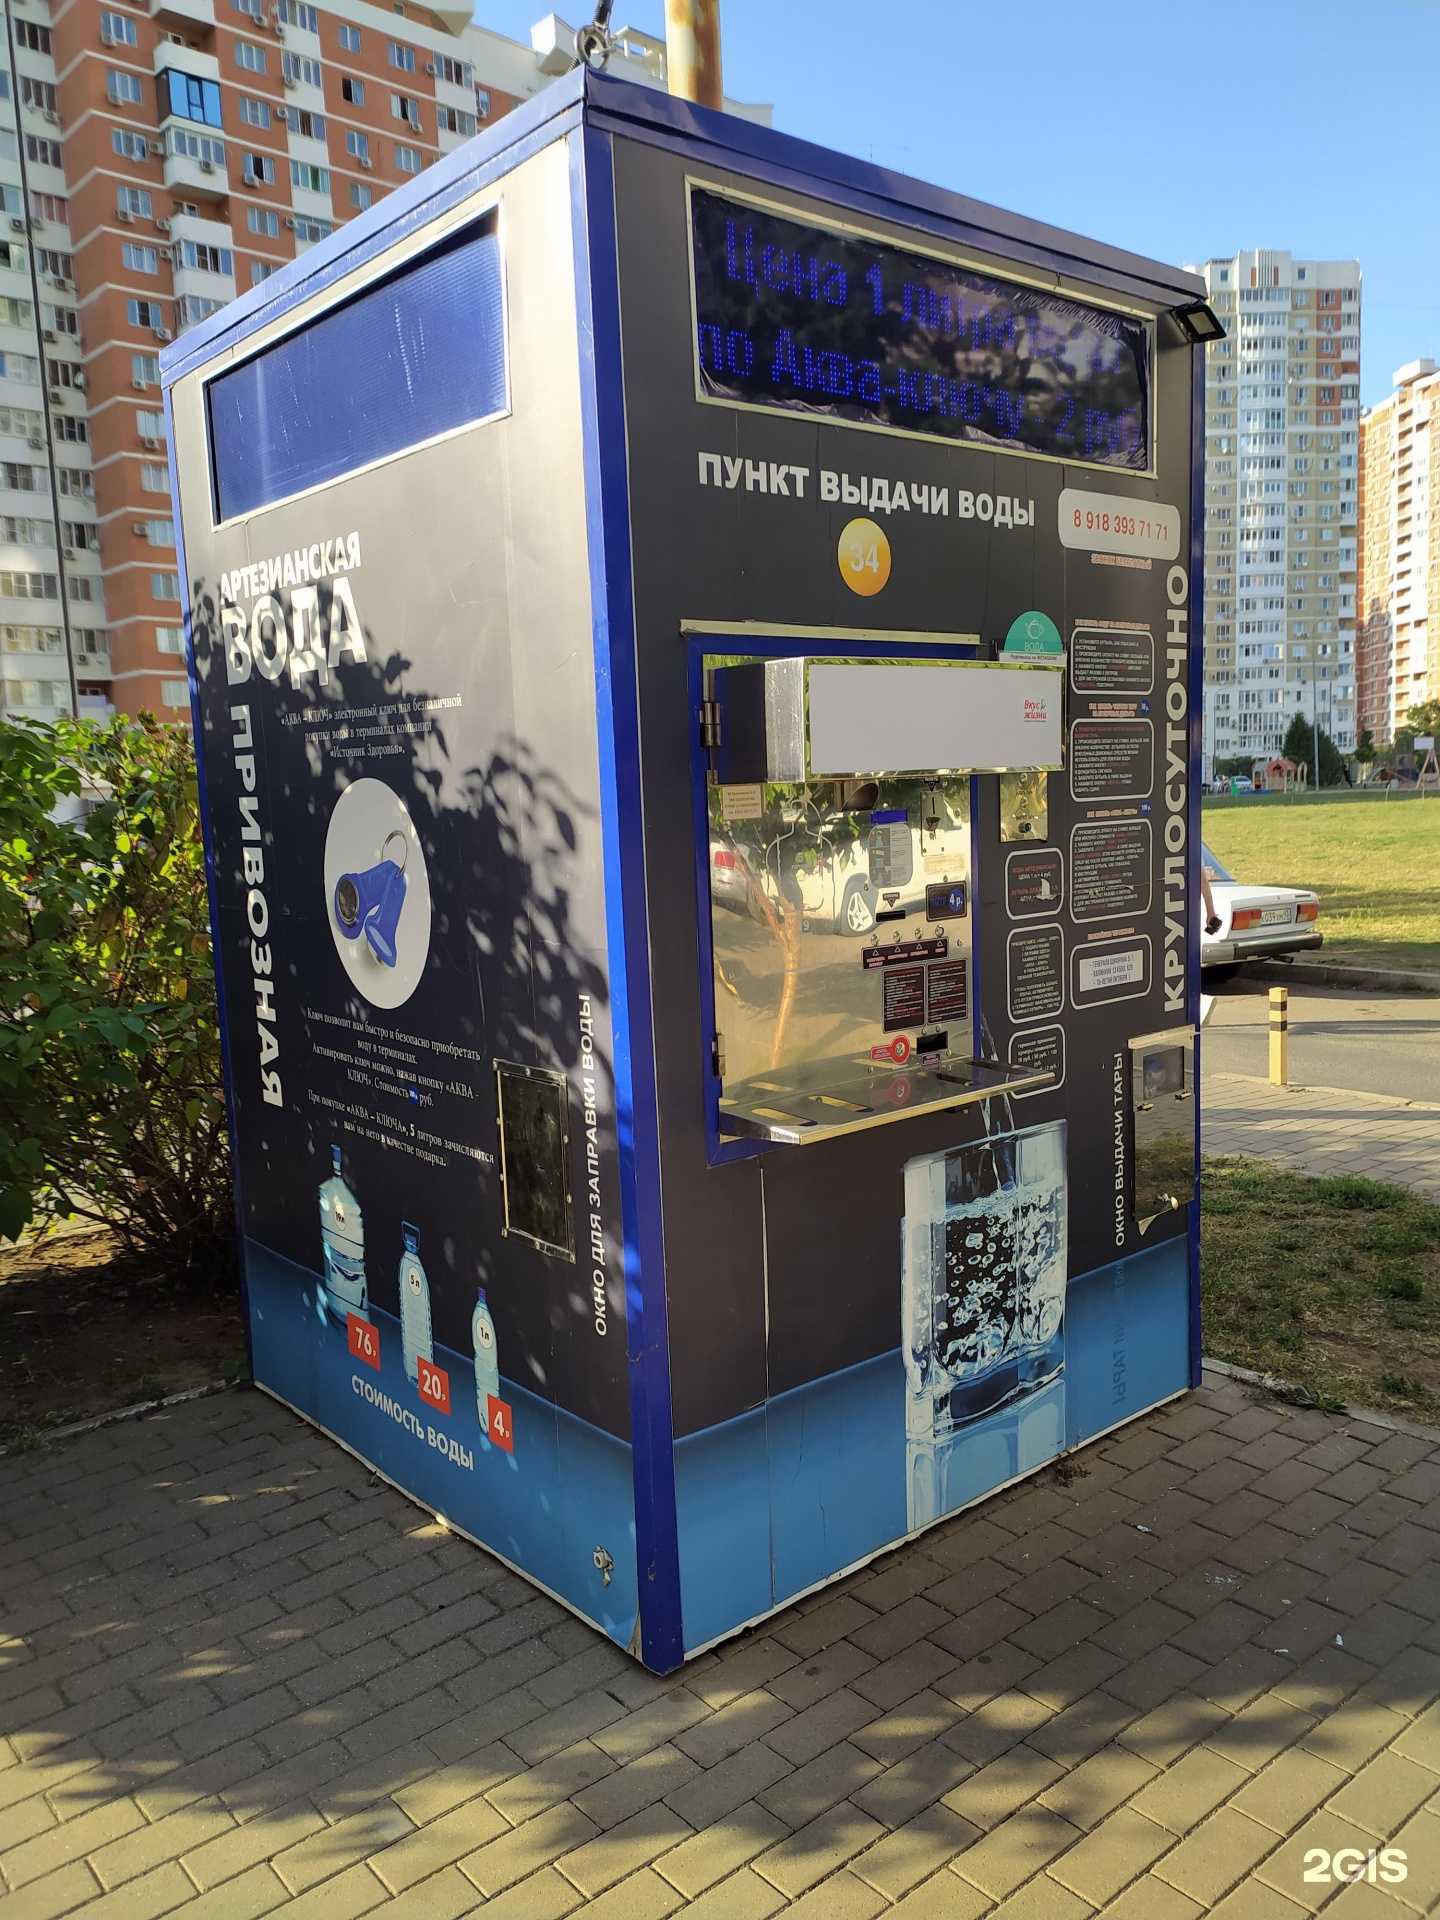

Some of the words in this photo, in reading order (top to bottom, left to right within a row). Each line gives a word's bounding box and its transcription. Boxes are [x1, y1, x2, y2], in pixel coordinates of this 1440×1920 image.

[726, 218, 848, 305] Цена
[866, 264, 886, 316] 1
[699, 322, 752, 376] по
[698, 452, 809, 498] ПУНКТ
[820, 470, 948, 515] ВЫДАЧИ
[957, 490, 1035, 529] ВОДЫ
[1074, 509, 1081, 528] 8
[1087, 511, 1109, 531] 918
[1114, 515, 1135, 535] 393
[1139, 520, 1151, 538] 71
[1156, 523, 1168, 541] 71
[220, 531, 362, 605] АРТЕЗИАНСКАЯ
[850, 543, 879, 573] 34
[221, 577, 368, 690] ВОДА
[334, 704, 378, 723] электронный
[356, 725, 395, 740] терминалах
[1024, 699, 1040, 712] Вкус
[1165, 565, 1188, 1012] КРУГЛОСУТОЧНО
[230, 704, 284, 1108] ПРИВОЗНАЯ
[949, 893, 955, 905] 4
[307, 1008, 323, 1022] Ключ
[324, 1014, 352, 1027] позволит
[353, 1021, 364, 1032] вам
[365, 1020, 389, 1040] быстро
[395, 1028, 430, 1049] безопасно
[431, 1040, 481, 1061] приобретать
[357, 1039, 372, 1054] воду
[578, 993, 595, 1070] ВОДЫ
[312, 1042, 354, 1064] Активировать
[354, 1054, 370, 1068] ключ
[418, 1074, 443, 1093] кнопку
[445, 1080, 474, 1099] «АКВА
[374, 1077, 409, 1098] Стоимость
[419, 1092, 434, 1107] руб.
[1113, 1052, 1123, 1106] ТАРЫ
[307, 1089, 321, 1106] При
[346, 1104, 369, 1120] «АКВА
[410, 1123, 416, 1137] 5
[416, 1129, 443, 1147] литров
[443, 1138, 494, 1164] зачисляются
[343, 1120, 356, 1133] вам
[357, 1126, 365, 1136] на
[386, 1135, 414, 1154] качестве
[583, 1077, 602, 1208] ЗАПРАВКИ
[1114, 1110, 1124, 1191] ВЫДАЧИ
[590, 1215, 605, 1266] ДЛЯ
[1115, 1195, 1125, 1246] ОКНО
[592, 1269, 606, 1336] ОКНО
[351, 1375, 424, 1440] СТОИМОСТЬ
[427, 1426, 474, 1472] ВОДЫ
